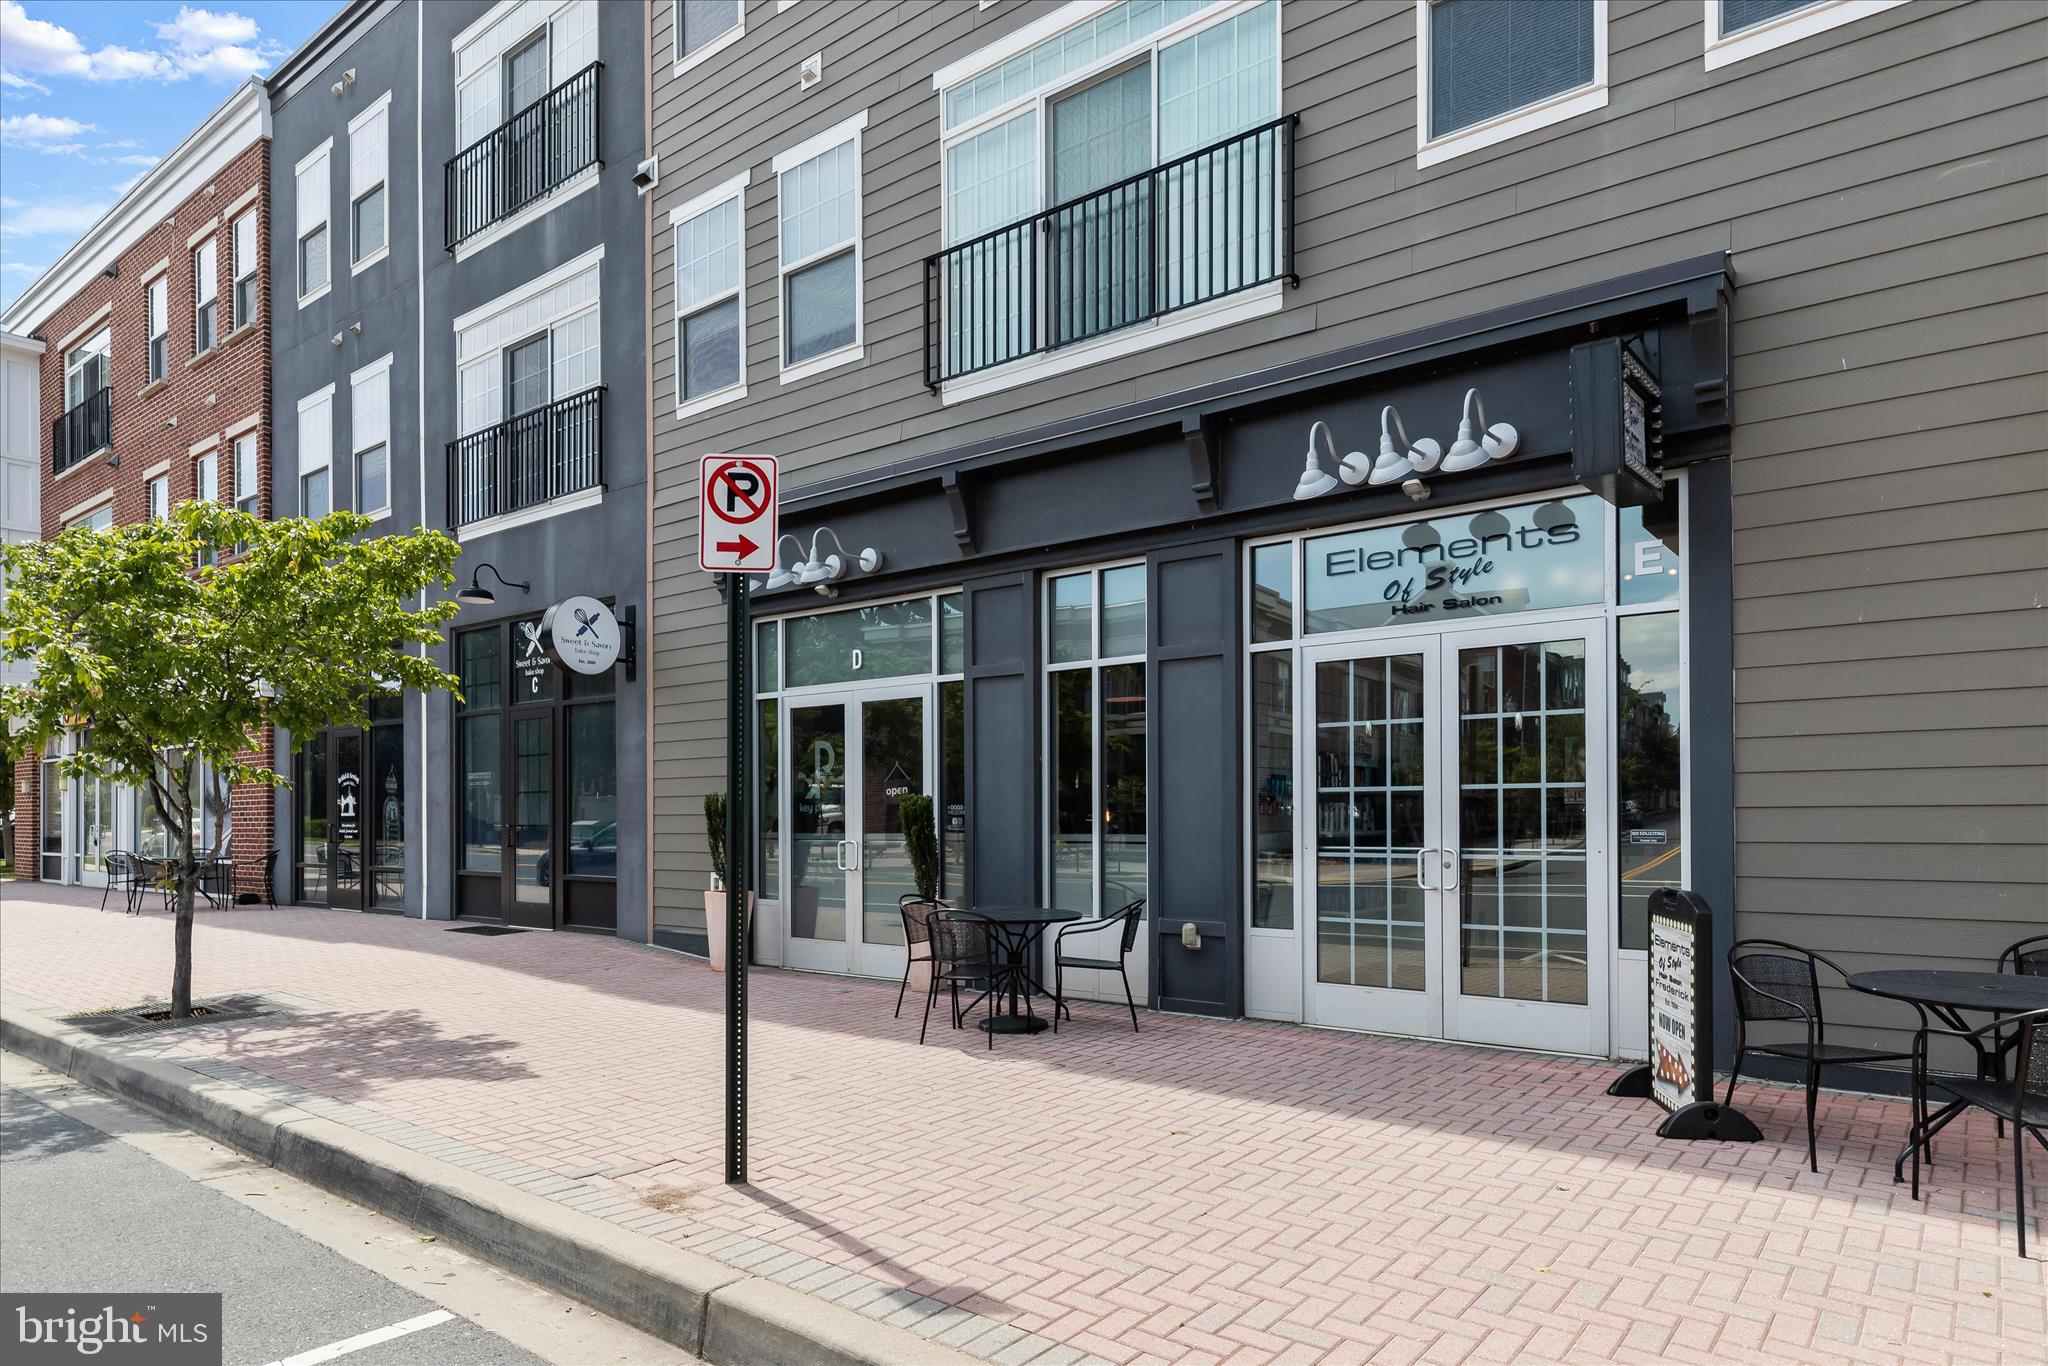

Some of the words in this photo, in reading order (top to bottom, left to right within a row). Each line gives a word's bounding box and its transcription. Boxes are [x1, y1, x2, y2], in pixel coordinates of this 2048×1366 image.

[727, 472, 759, 512] P
[1326, 523, 1580, 576] Elements
[1634, 539, 1664, 576] E
[1383, 577, 1414, 603] Of
[1425, 558, 1495, 591] Style
[1391, 601, 1436, 616] Hair
[1442, 594, 1504, 612] Salon
[561, 636, 582, 646] Sweet
[592, 641, 612, 651] Savory
[515, 659, 531, 668] Sweet
[532, 657, 537, 665] &
[852, 649, 862, 670] D
[535, 668, 544, 676] shop
[532, 676, 538, 694] C
[885, 786, 909, 798] open
[1655, 934, 1690, 958] Elements
[1659, 956, 1666, 972] Of
[1667, 955, 1682, 971] Style
[1656, 978, 1690, 1002] Frederick
[1659, 1011, 1671, 1033] NOW
[1672, 1018, 1686, 1041] OPEN
